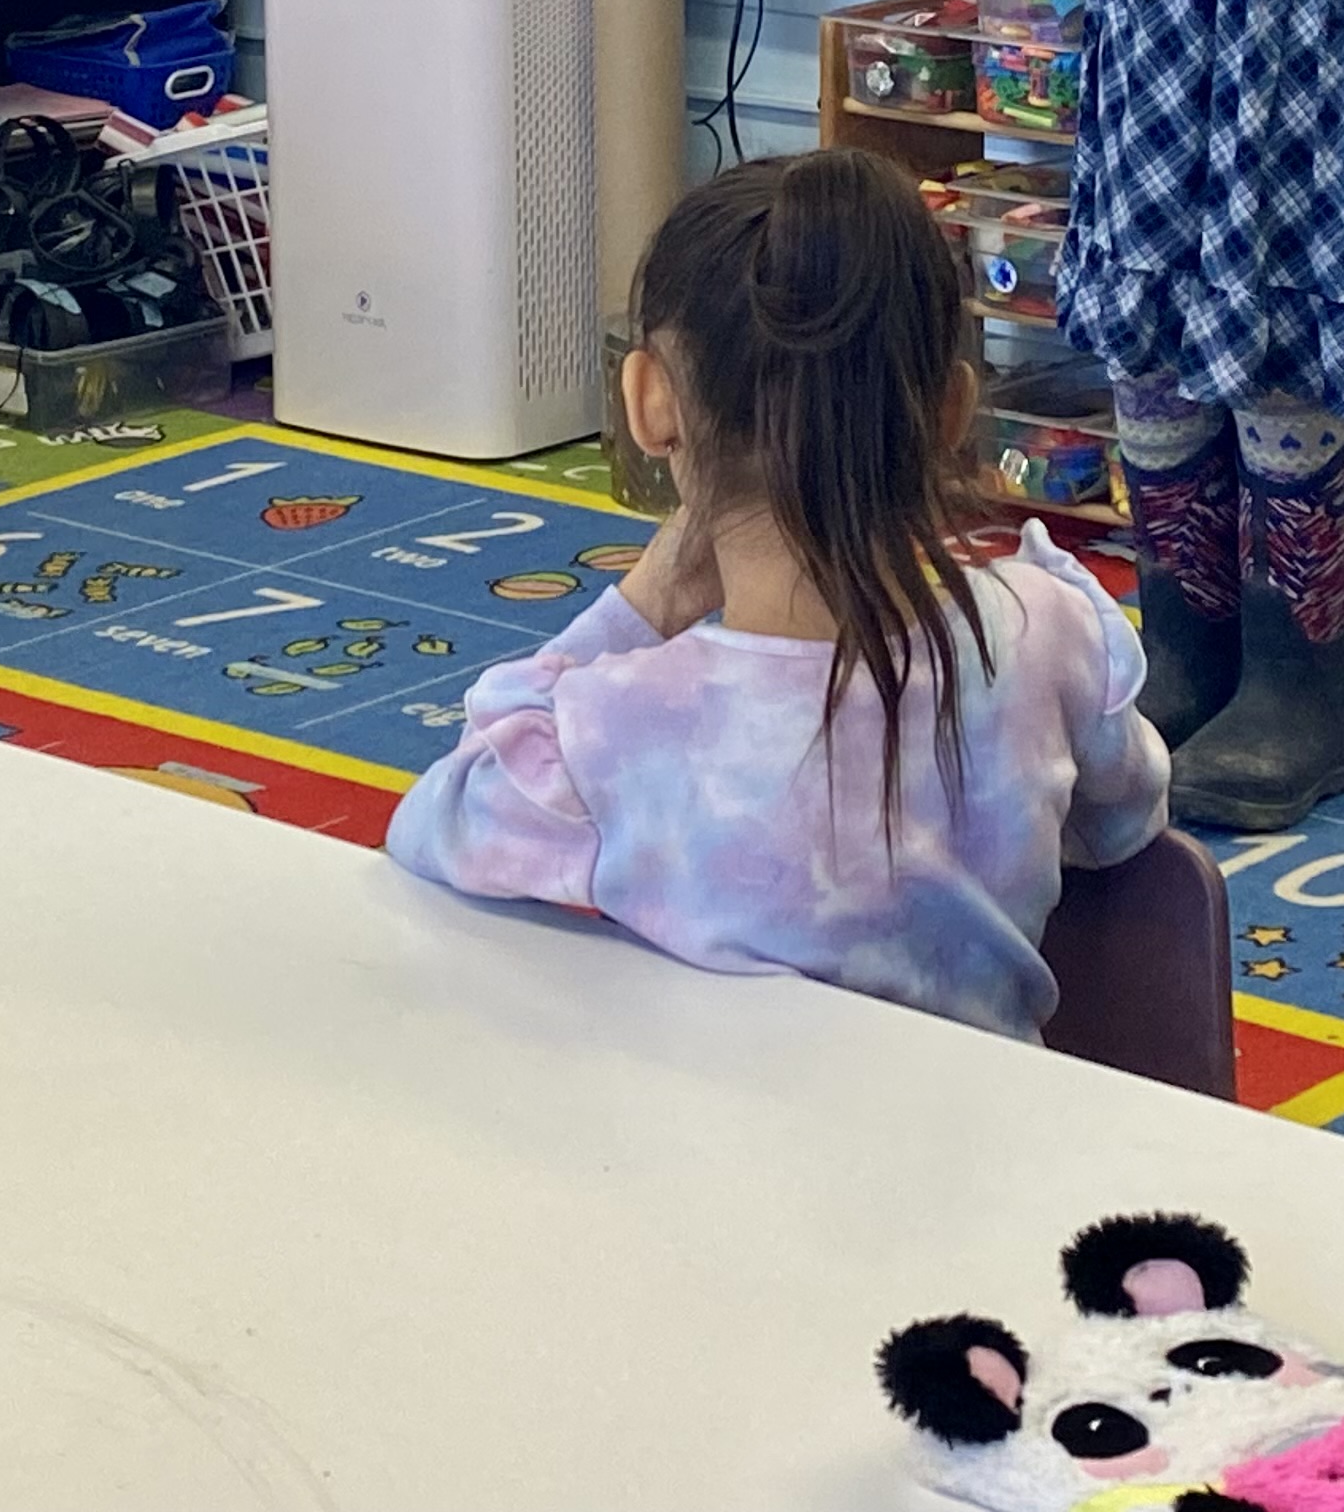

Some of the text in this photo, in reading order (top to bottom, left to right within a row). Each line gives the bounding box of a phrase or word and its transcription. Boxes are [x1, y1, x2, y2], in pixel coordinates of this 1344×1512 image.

[182, 461, 288, 493] 1
[113, 488, 186, 509] one
[415, 511, 545, 555] 2
[371, 545, 448, 569] two
[173, 587, 326, 628] 7
[94, 624, 213, 659] seven
